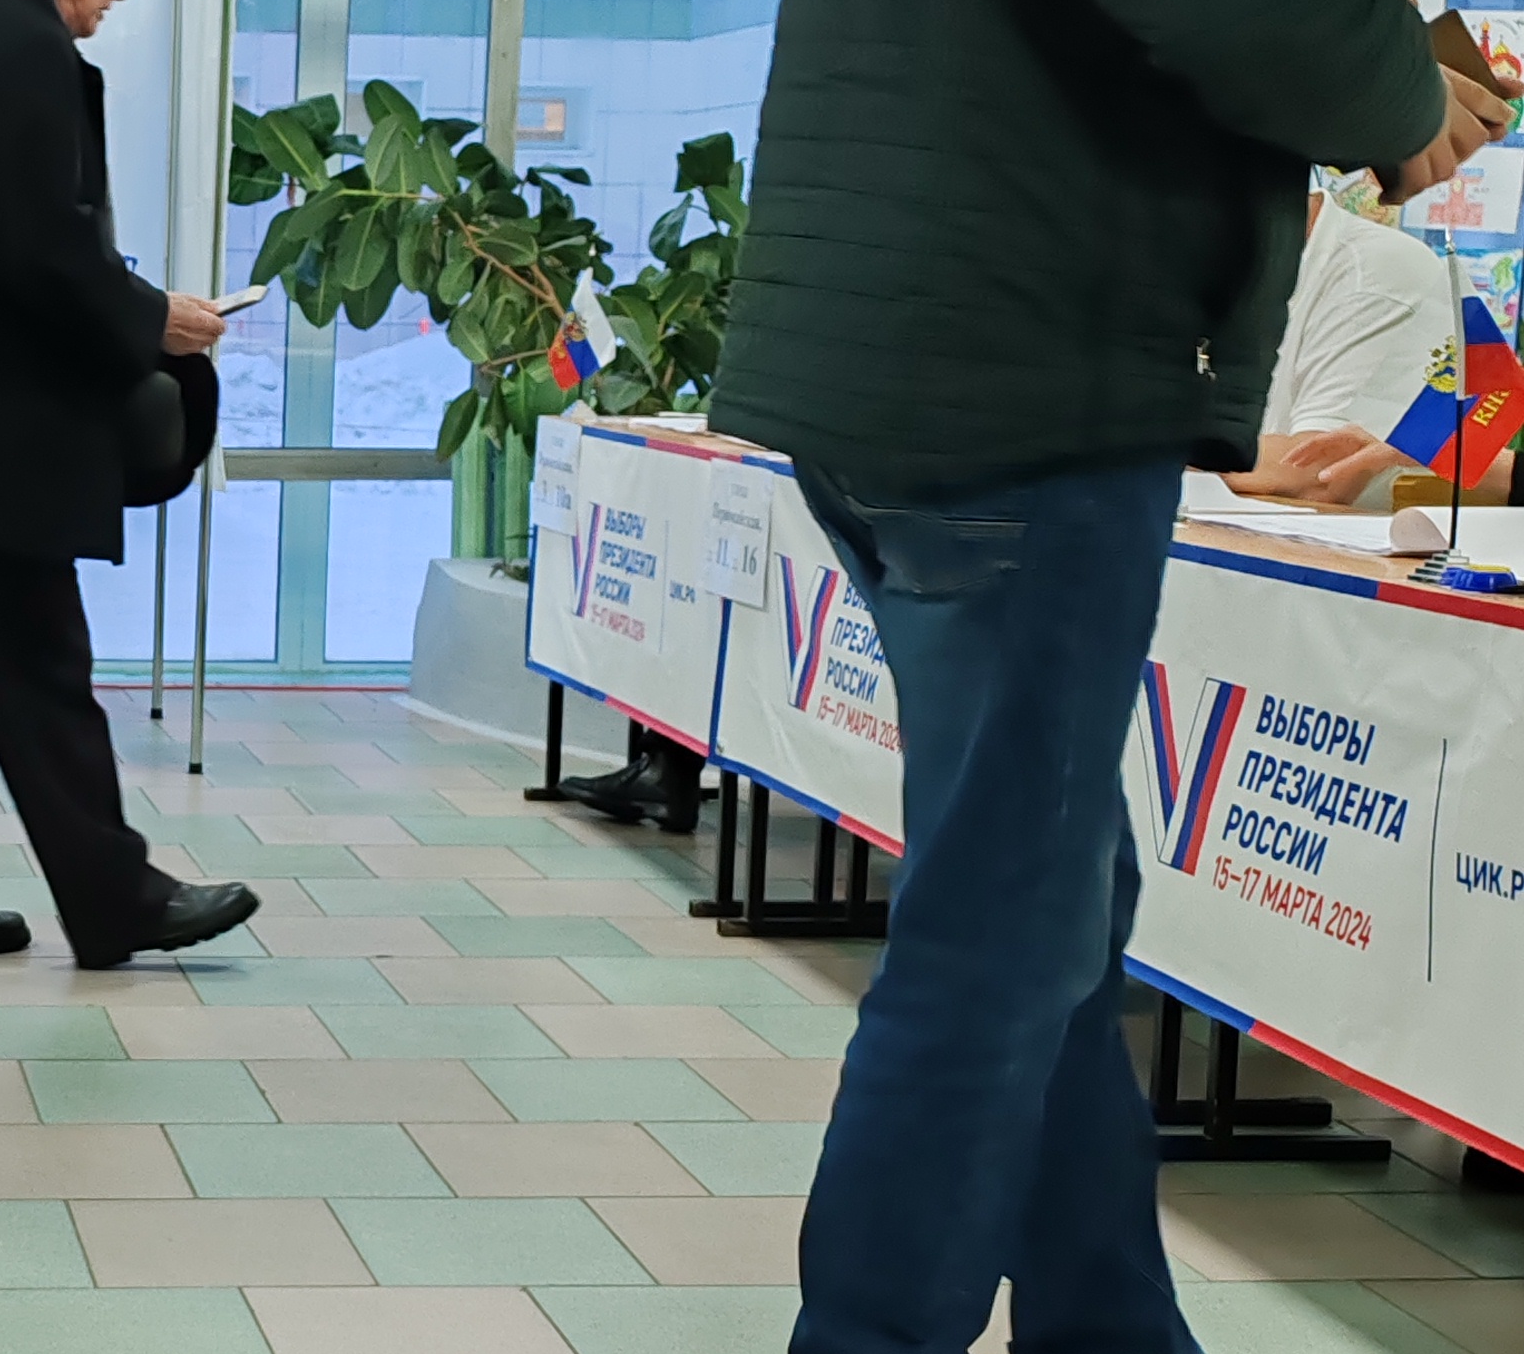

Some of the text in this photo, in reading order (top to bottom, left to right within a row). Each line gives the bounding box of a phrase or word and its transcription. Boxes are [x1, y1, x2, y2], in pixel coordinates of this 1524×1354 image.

[604, 507, 647, 540] ВЫБОРЫ
[599, 540, 657, 581] ПРЕЗИДЕНТА
[742, 545, 758, 576] 16
[594, 572, 632, 606] РОССИИ
[825, 657, 879, 704] РОССИИ
[844, 706, 877, 743] МАРТА
[1255, 694, 1376, 766] ВЫБОРЫ
[1237, 750, 1408, 843] ПРЕЗИДЕНТА
[1222, 803, 1328, 876] РОССИИ
[1260, 874, 1325, 931] МАРТА
[1325, 901, 1372, 951] 2024
